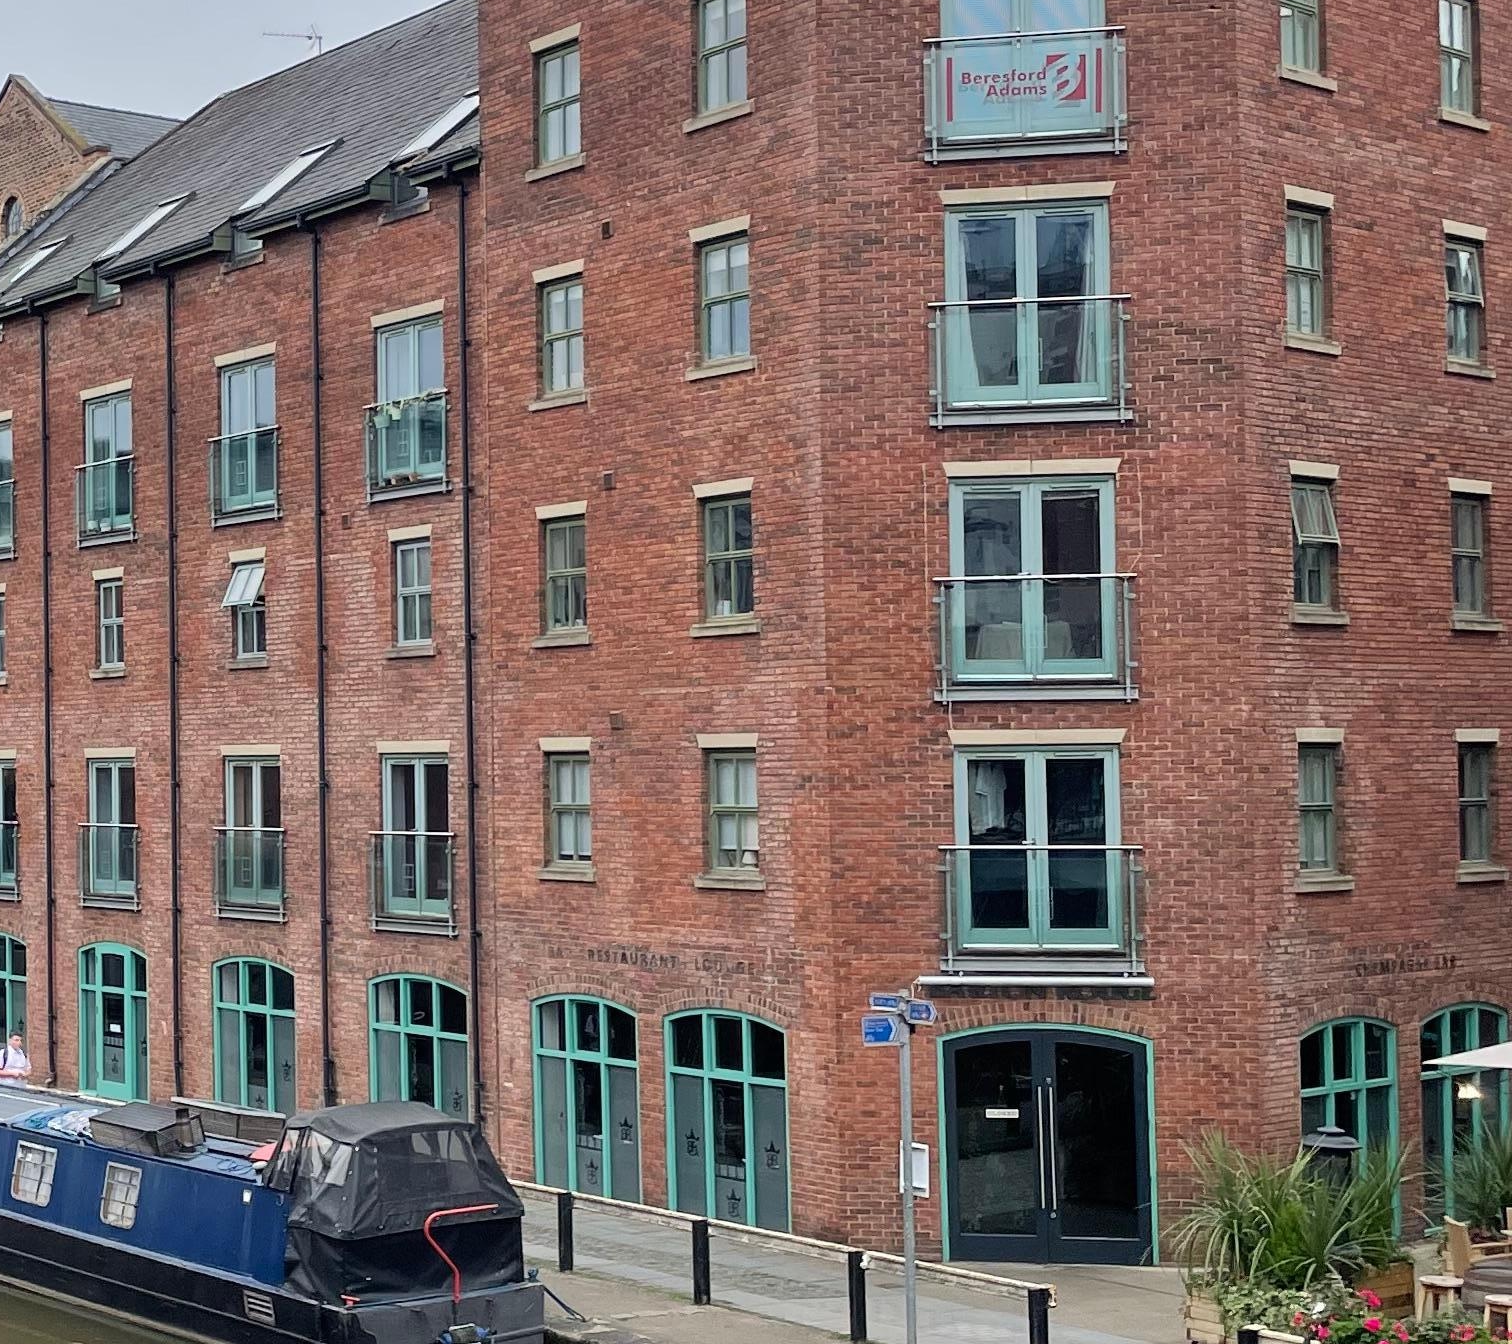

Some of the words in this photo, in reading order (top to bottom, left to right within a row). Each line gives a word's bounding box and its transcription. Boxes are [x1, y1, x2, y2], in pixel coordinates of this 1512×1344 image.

[961, 67, 1047, 85] Beresford
[986, 83, 1047, 98] Adams
[587, 948, 680, 969] RESTAURANT
[695, 956, 754, 976] LOUNGE
